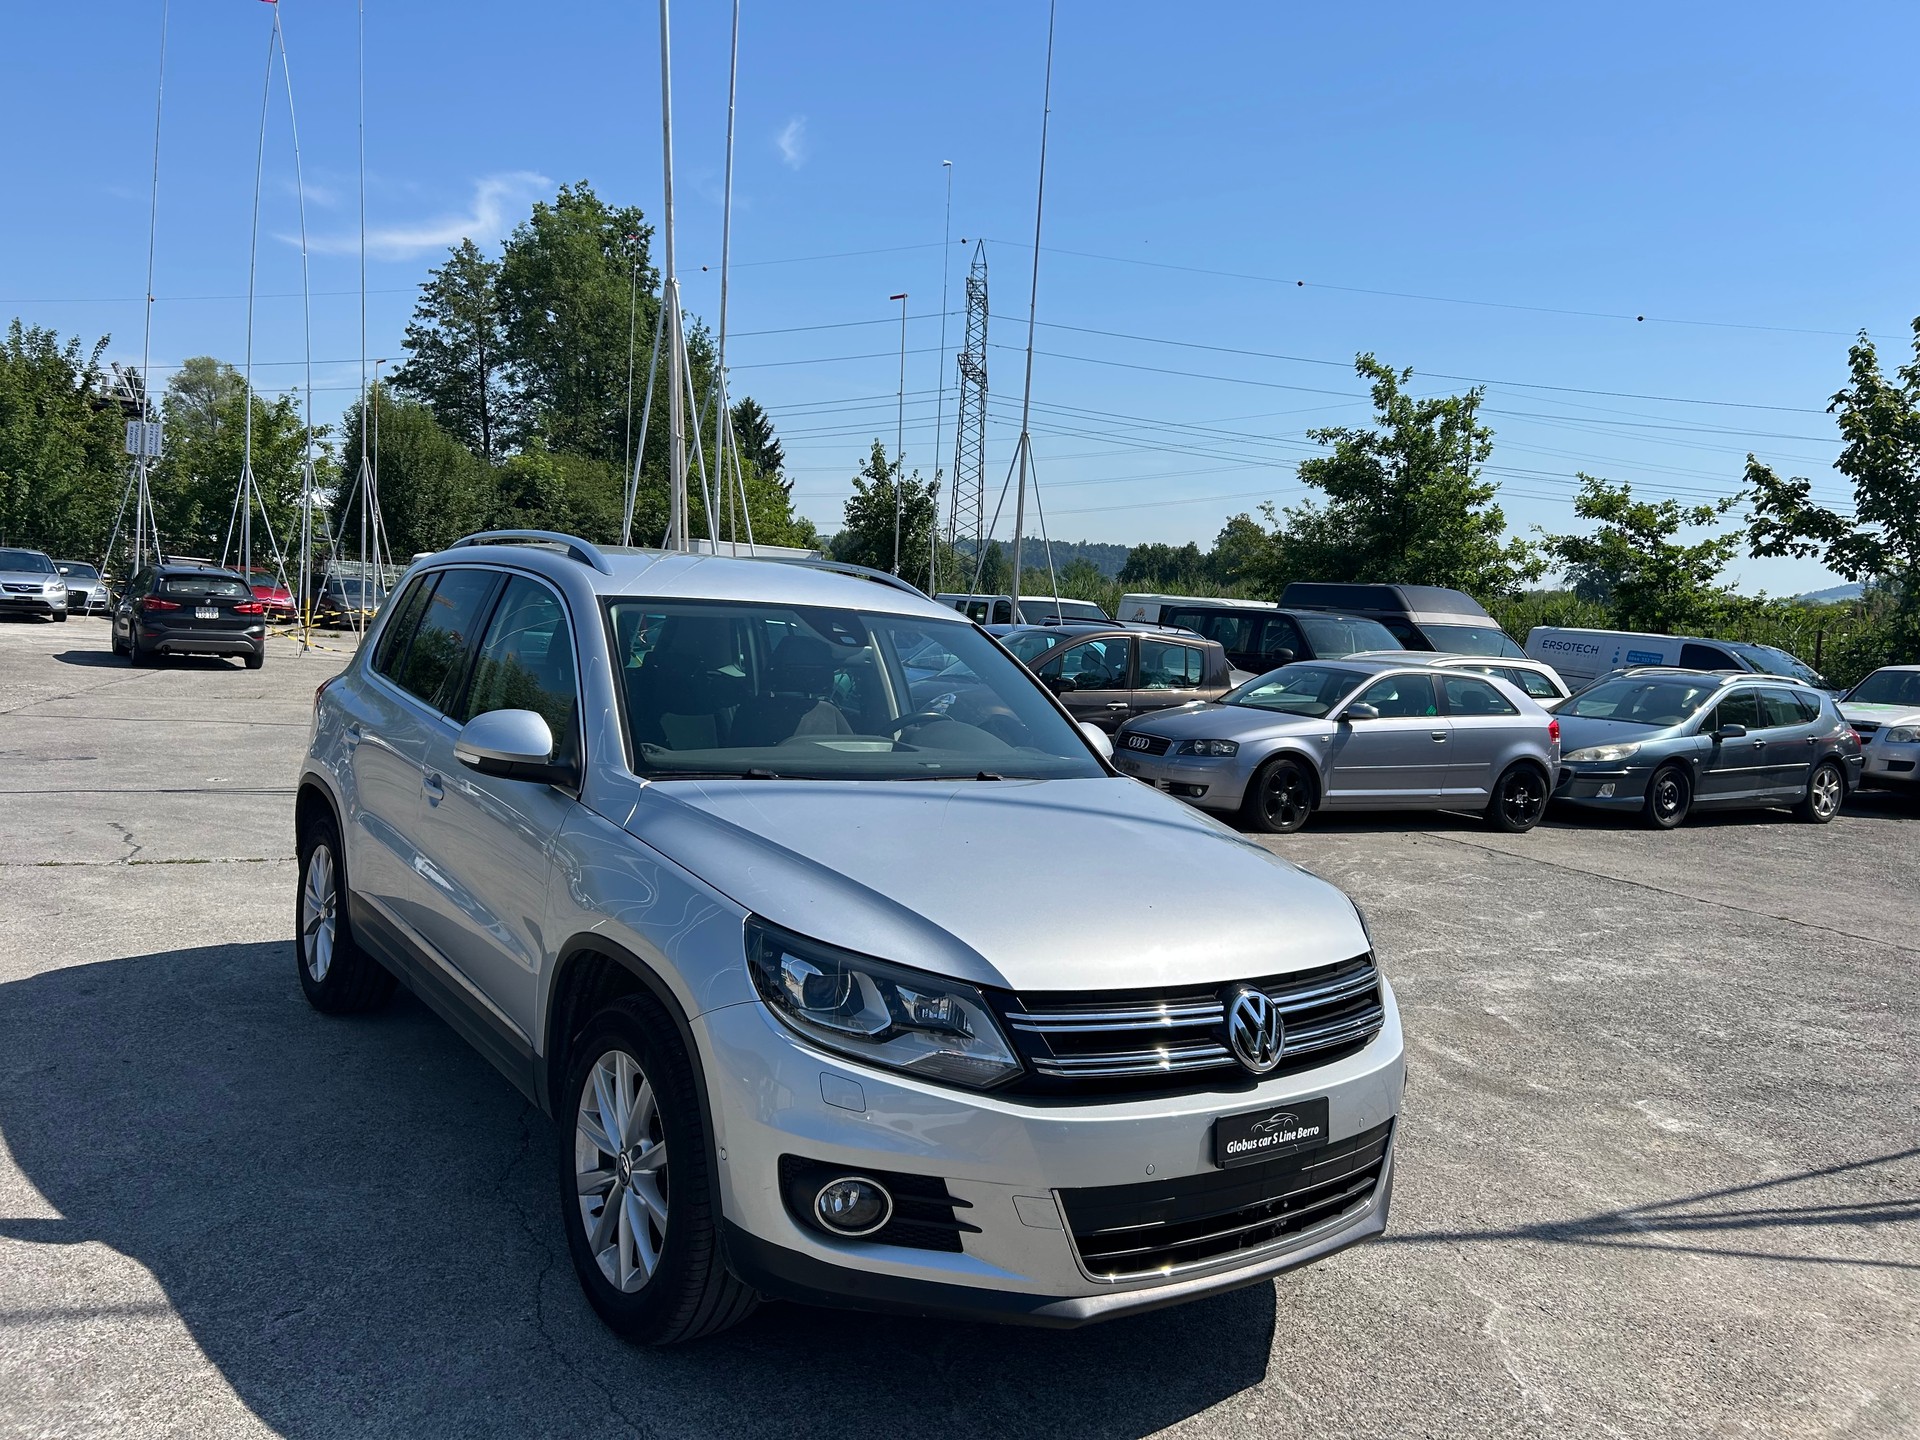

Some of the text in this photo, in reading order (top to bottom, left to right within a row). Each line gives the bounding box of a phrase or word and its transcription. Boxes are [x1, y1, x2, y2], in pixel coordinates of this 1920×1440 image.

[1542, 639, 1599, 654] ERSOTECH
[1226, 1126, 1320, 1154] Globus car S Line Berro
